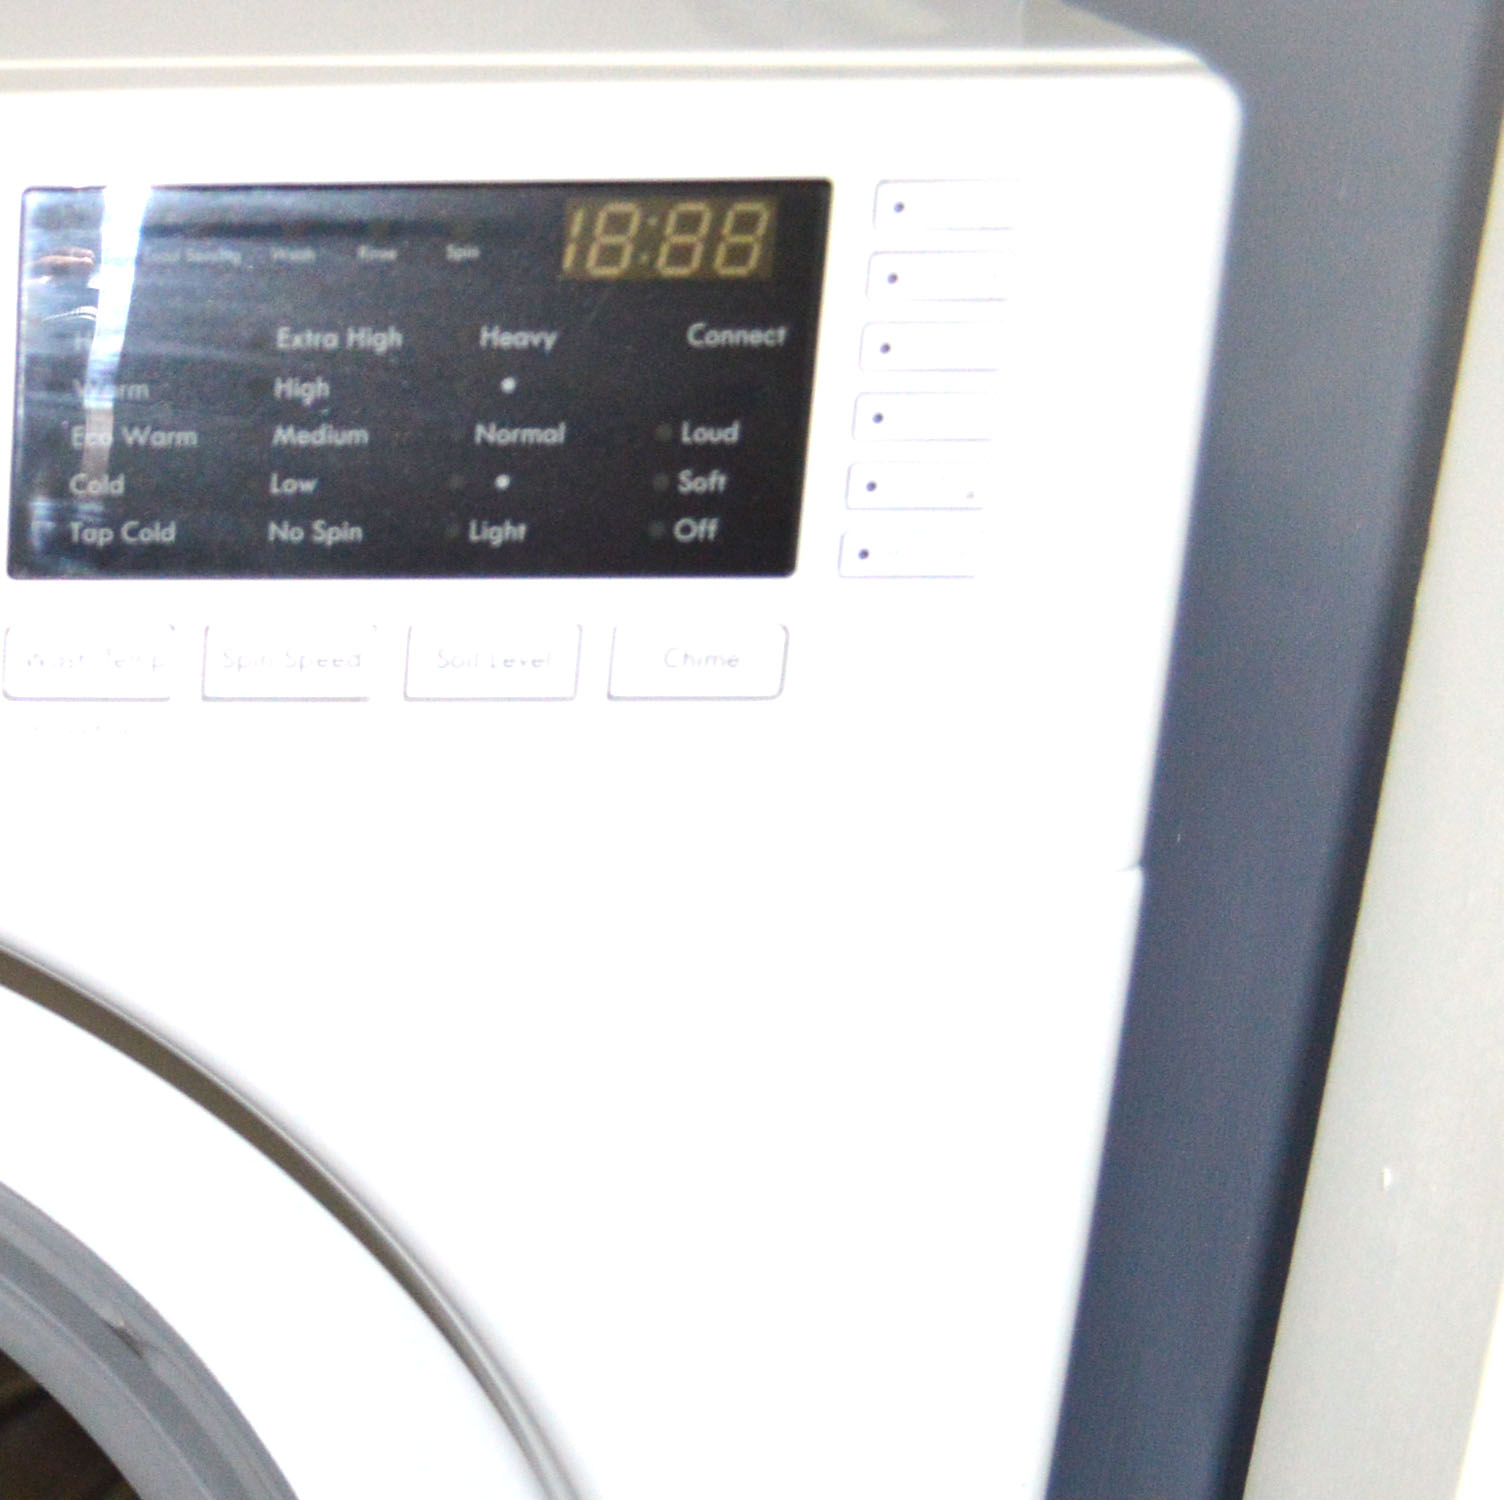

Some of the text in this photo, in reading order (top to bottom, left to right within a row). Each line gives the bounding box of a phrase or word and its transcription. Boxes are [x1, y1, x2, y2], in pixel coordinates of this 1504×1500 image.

[562, 202, 770, 279] 18:88
[276, 327, 403, 354] Extra High
[480, 325, 559, 355] Heavy
[687, 322, 787, 348] Connect
[274, 377, 330, 405] High
[122, 427, 199, 448] Warm
[272, 424, 370, 447] Medium
[474, 421, 566, 445] Normal
[681, 421, 741, 444] Loud
[69, 473, 125, 496] Cold
[269, 473, 318, 495] Low
[677, 468, 727, 493] Soft
[71, 520, 176, 546] Tap Cold
[268, 520, 364, 546] No Spin
[469, 520, 528, 547] Light
[674, 517, 720, 541] Off
[663, 647, 741, 670] Chime
